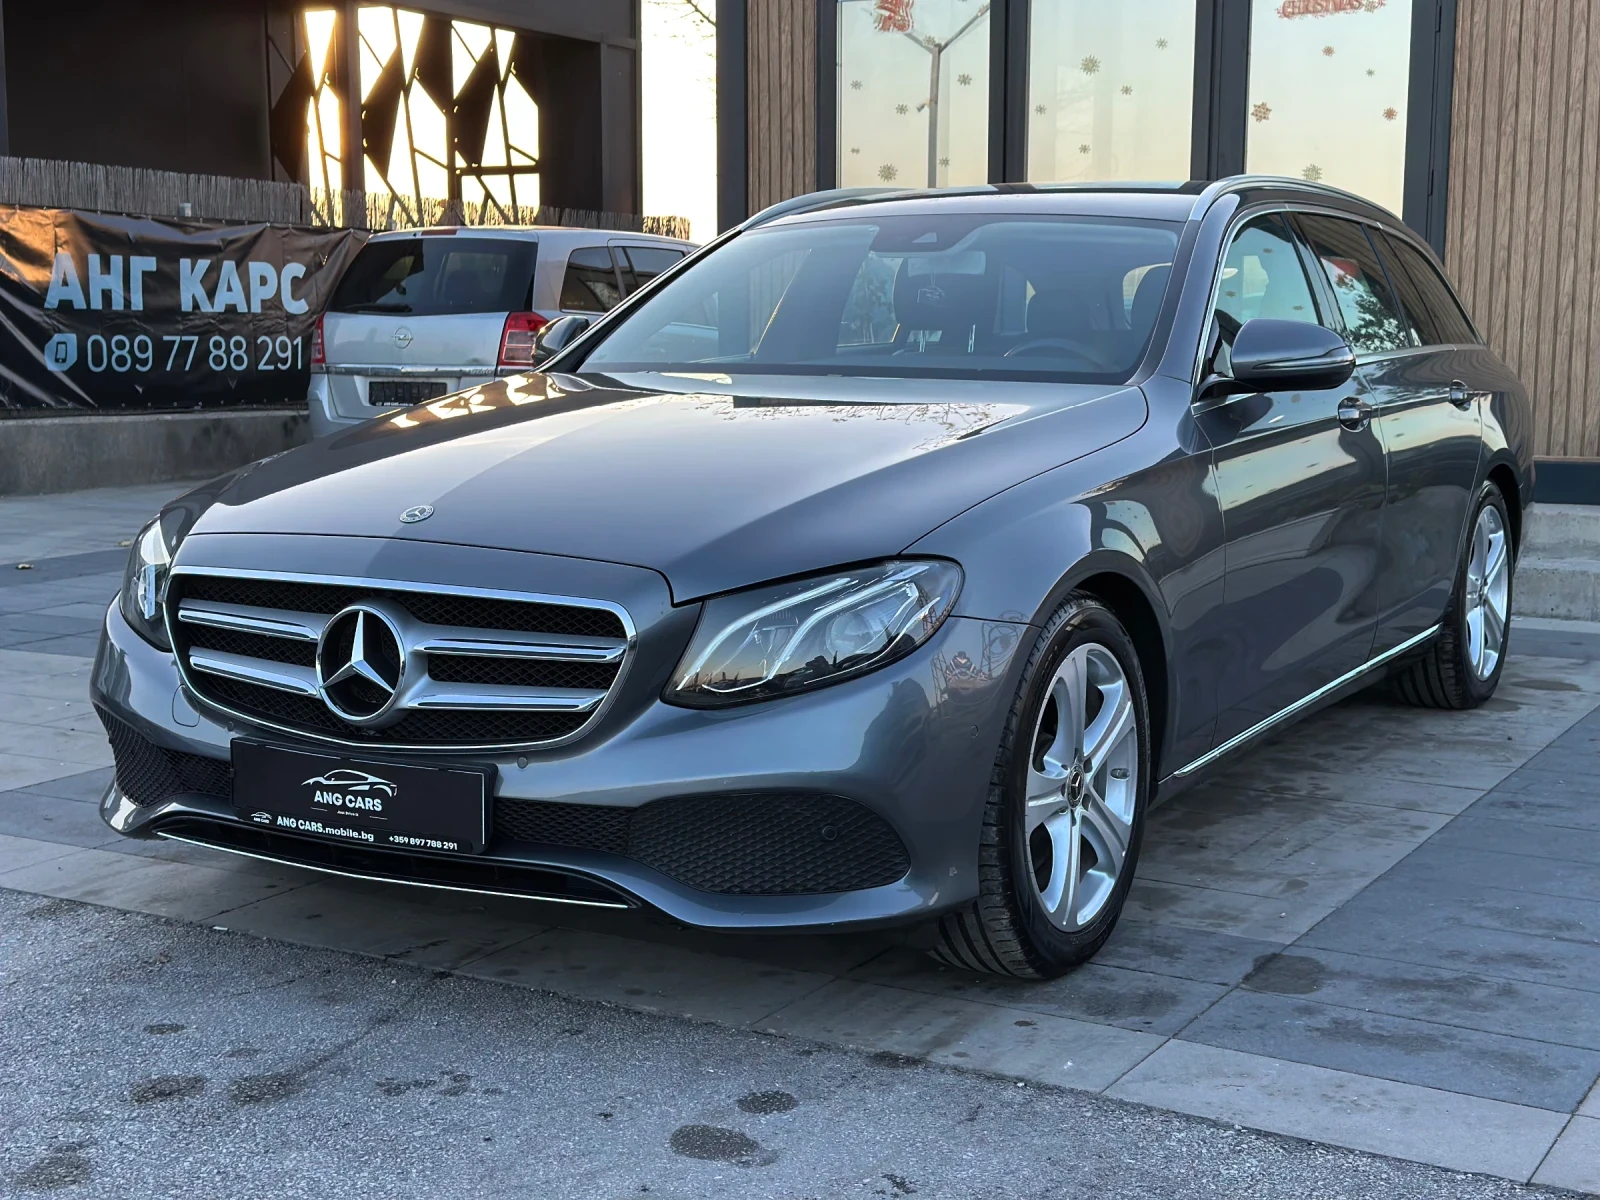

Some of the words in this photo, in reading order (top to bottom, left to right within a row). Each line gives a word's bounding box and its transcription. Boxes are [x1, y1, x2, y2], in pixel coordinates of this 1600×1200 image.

[44, 251, 157, 311] АНГ
[179, 258, 310, 315] КАРС
[87, 334, 153, 372] 089
[163, 335, 199, 372] 77
[209, 335, 249, 371] 88
[257, 335, 302, 371] 291
[314, 790, 343, 806] ANG
[345, 795, 383, 811] CARS
[276, 815, 297, 828] ANG
[298, 819, 375, 842] CARS.mobile.bg
[389, 835, 409, 844] +359
[409, 837, 425, 846] 897
[425, 839, 442, 848] 788
[443, 841, 458, 850] 291
